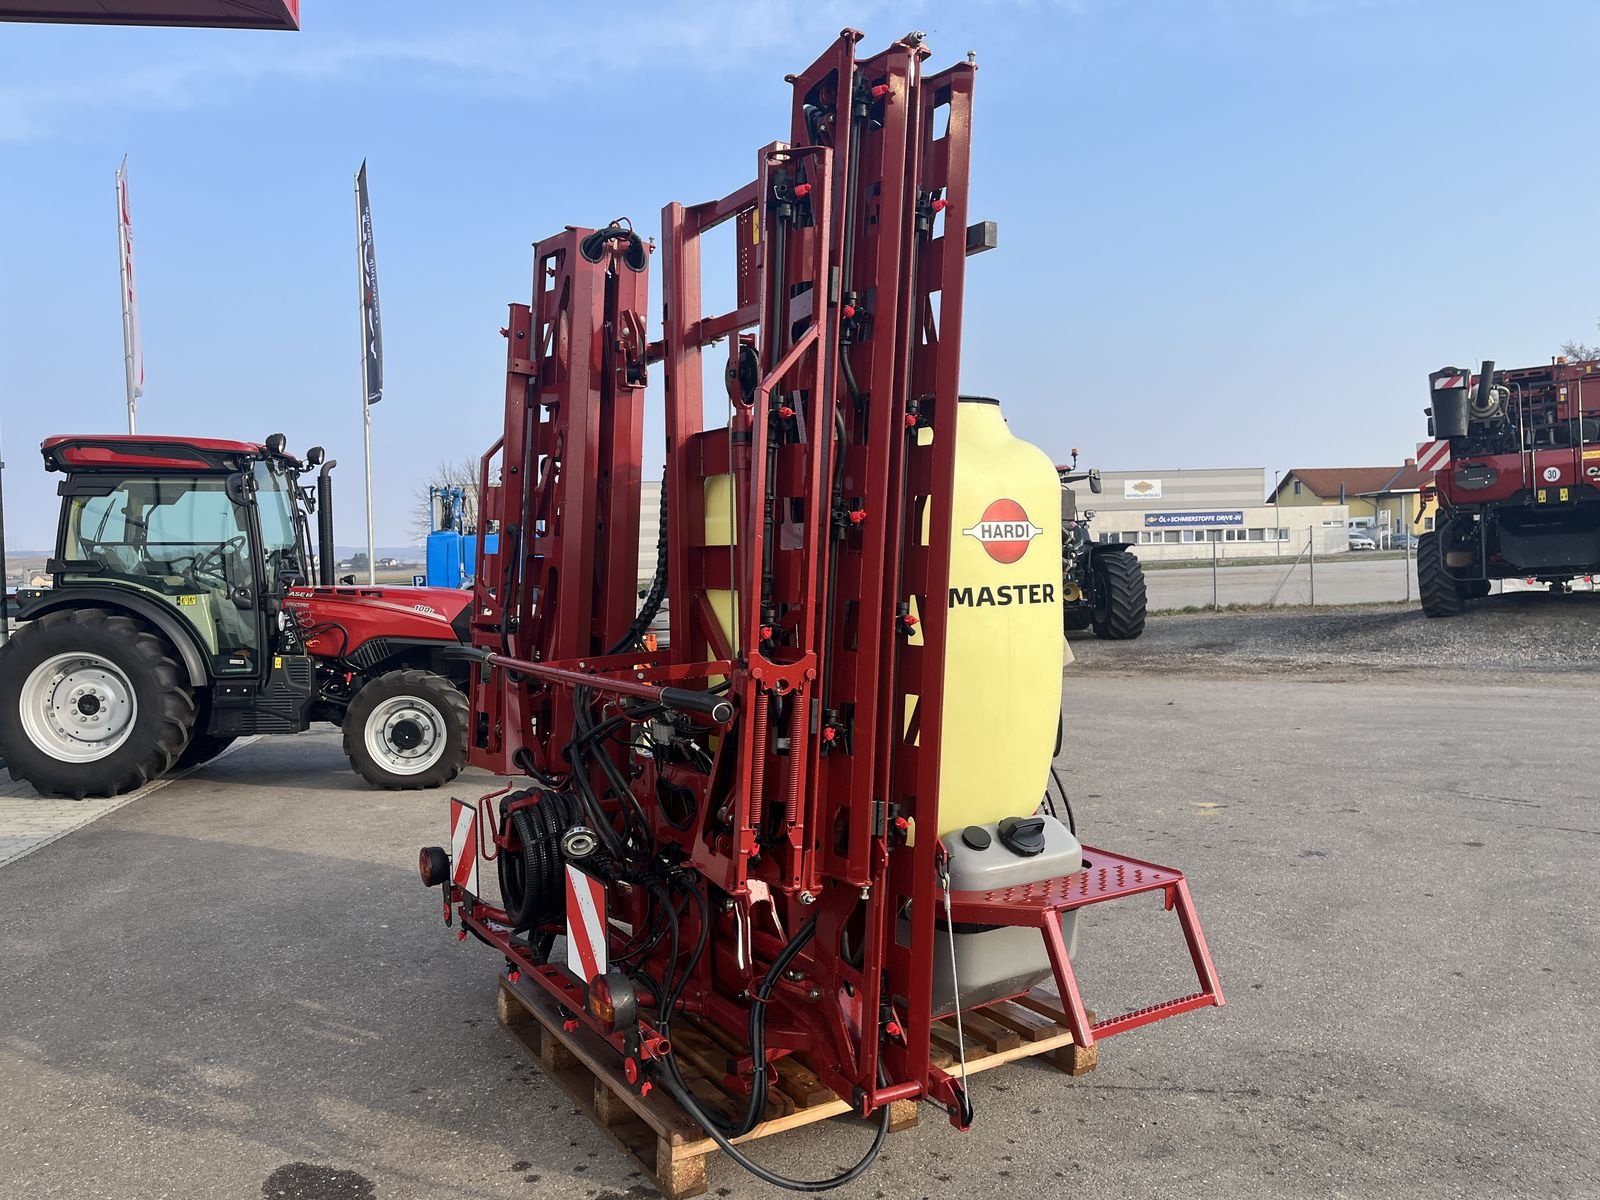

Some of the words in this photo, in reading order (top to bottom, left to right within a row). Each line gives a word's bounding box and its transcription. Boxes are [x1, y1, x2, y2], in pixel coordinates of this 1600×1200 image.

[1547, 469, 1557, 479] 30
[981, 524, 1029, 539] HARDI
[415, 576, 424, 587] P
[948, 583, 1055, 608] MASTER
